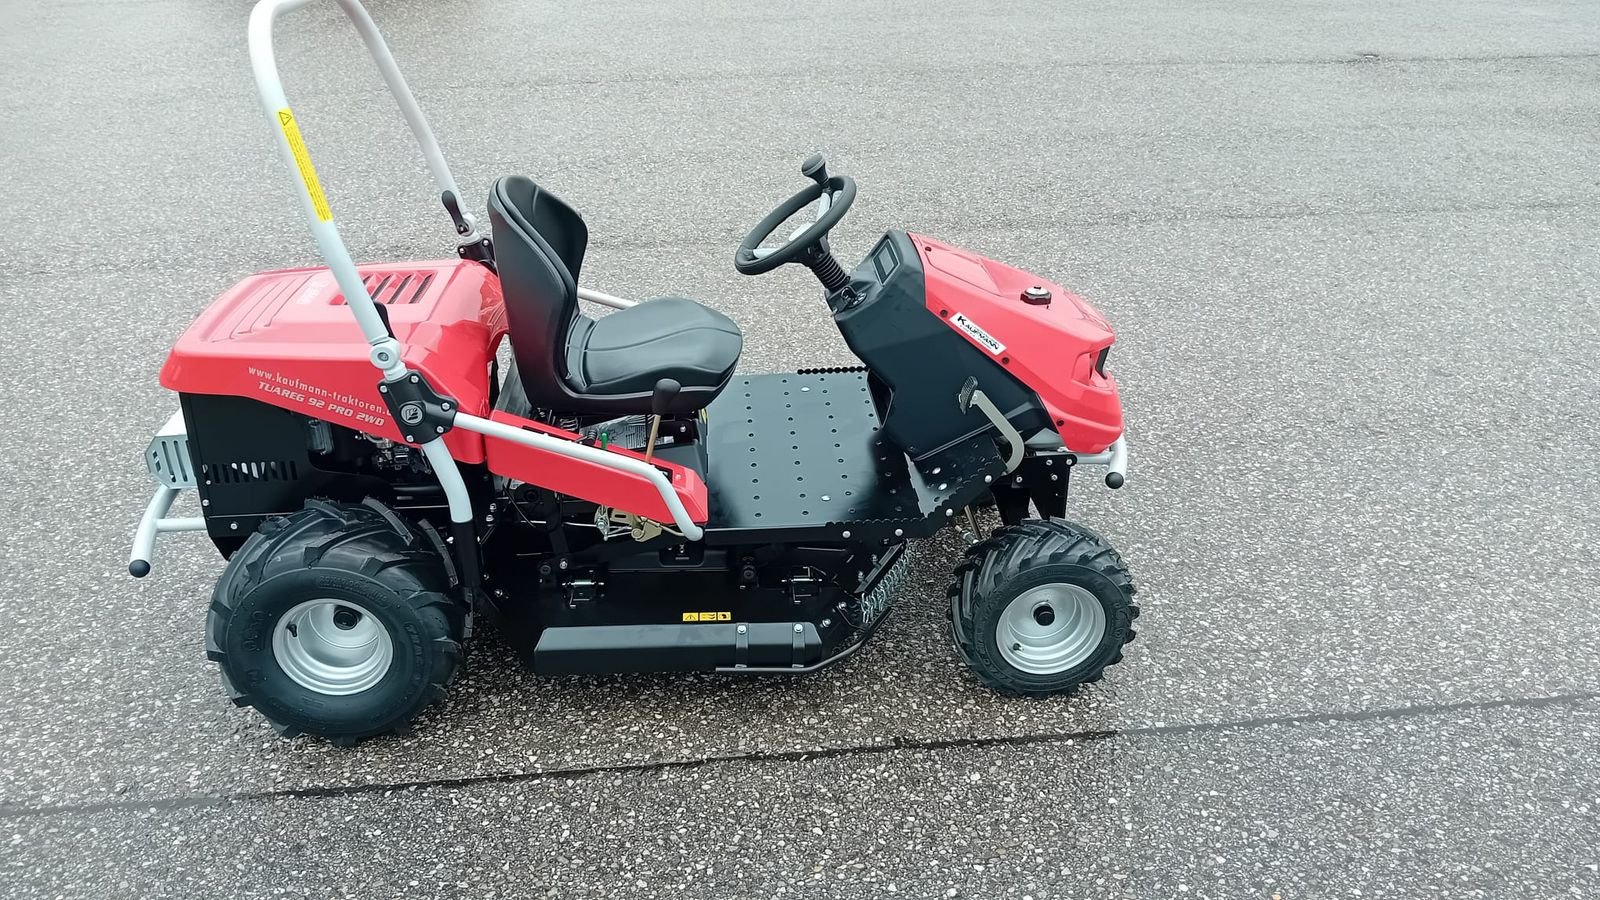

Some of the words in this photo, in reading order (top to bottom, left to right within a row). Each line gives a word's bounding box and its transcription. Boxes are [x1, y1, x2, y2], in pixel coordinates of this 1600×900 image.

[957, 315, 999, 350] KAUFMANN
[258, 381, 305, 402] TUAREG
[308, 397, 326, 408] 92
[328, 403, 354, 417] PRO
[356, 412, 385, 426] 2WD
